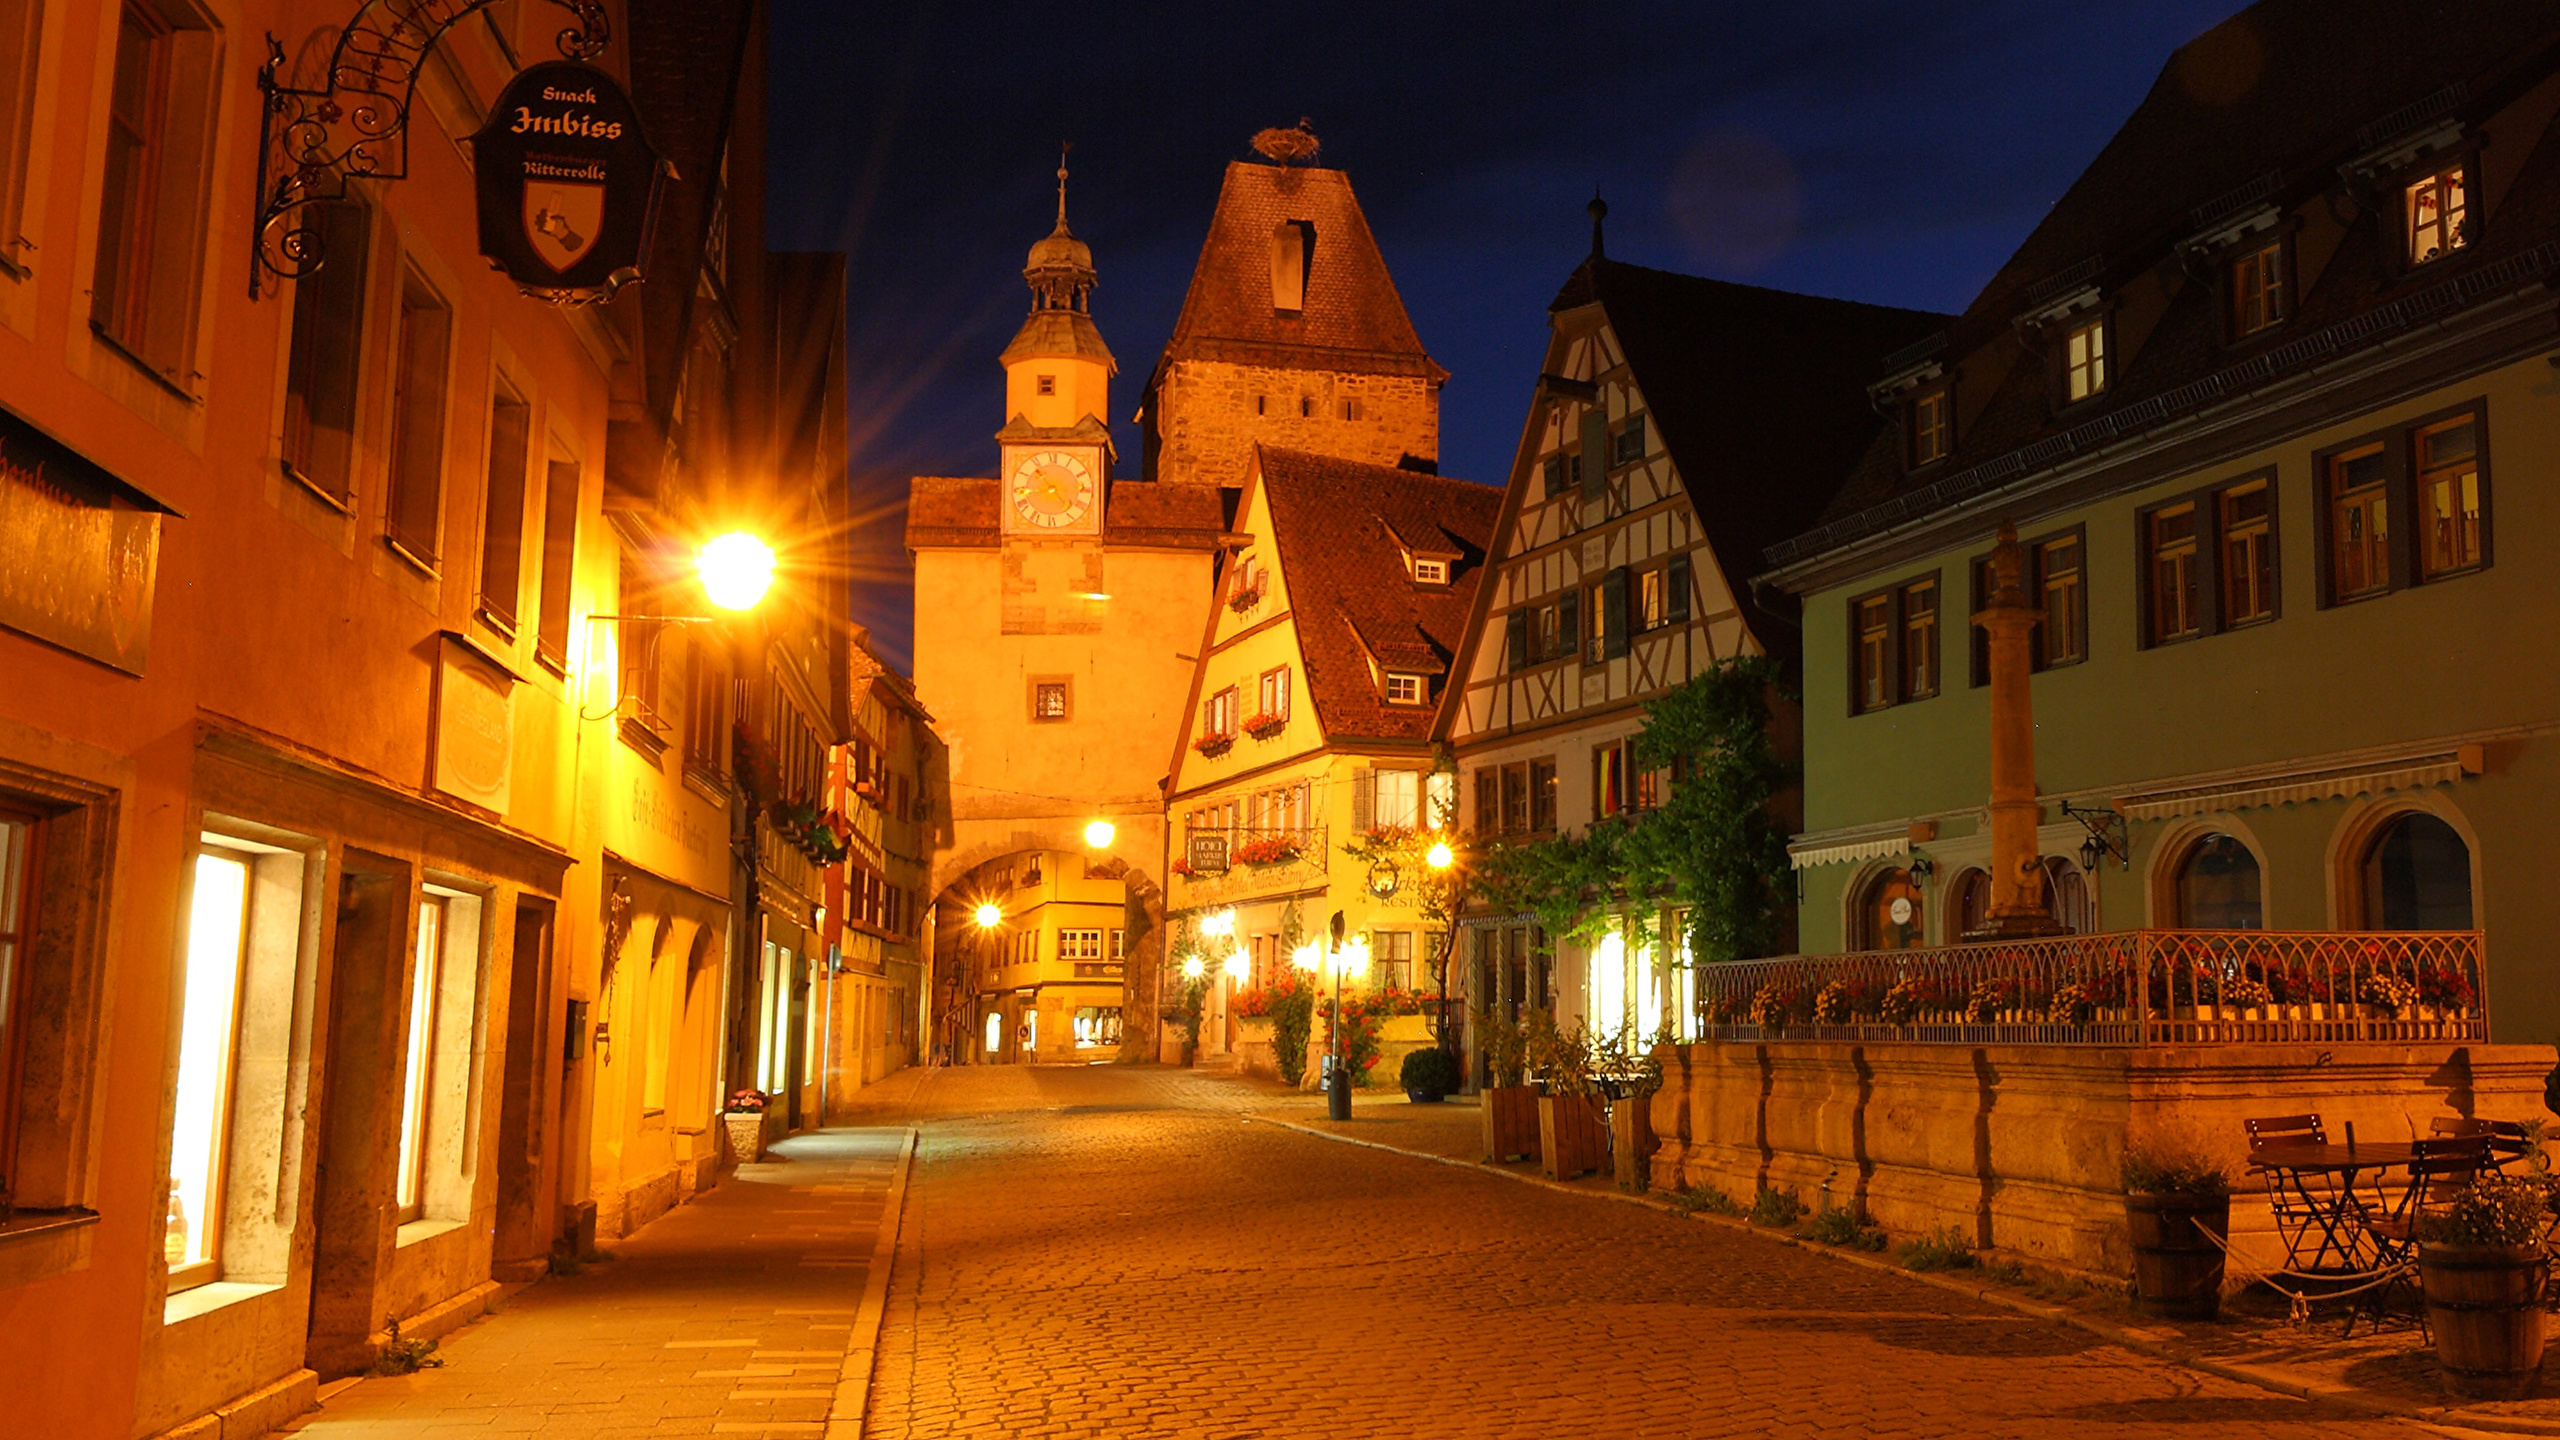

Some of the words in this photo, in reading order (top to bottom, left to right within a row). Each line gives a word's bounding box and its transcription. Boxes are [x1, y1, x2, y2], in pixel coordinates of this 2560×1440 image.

[542, 86, 597, 104] Snack
[510, 106, 623, 140] Imbiss
[521, 161, 607, 181] Ritterrolle
[1195, 840, 1222, 852] HOTEL
